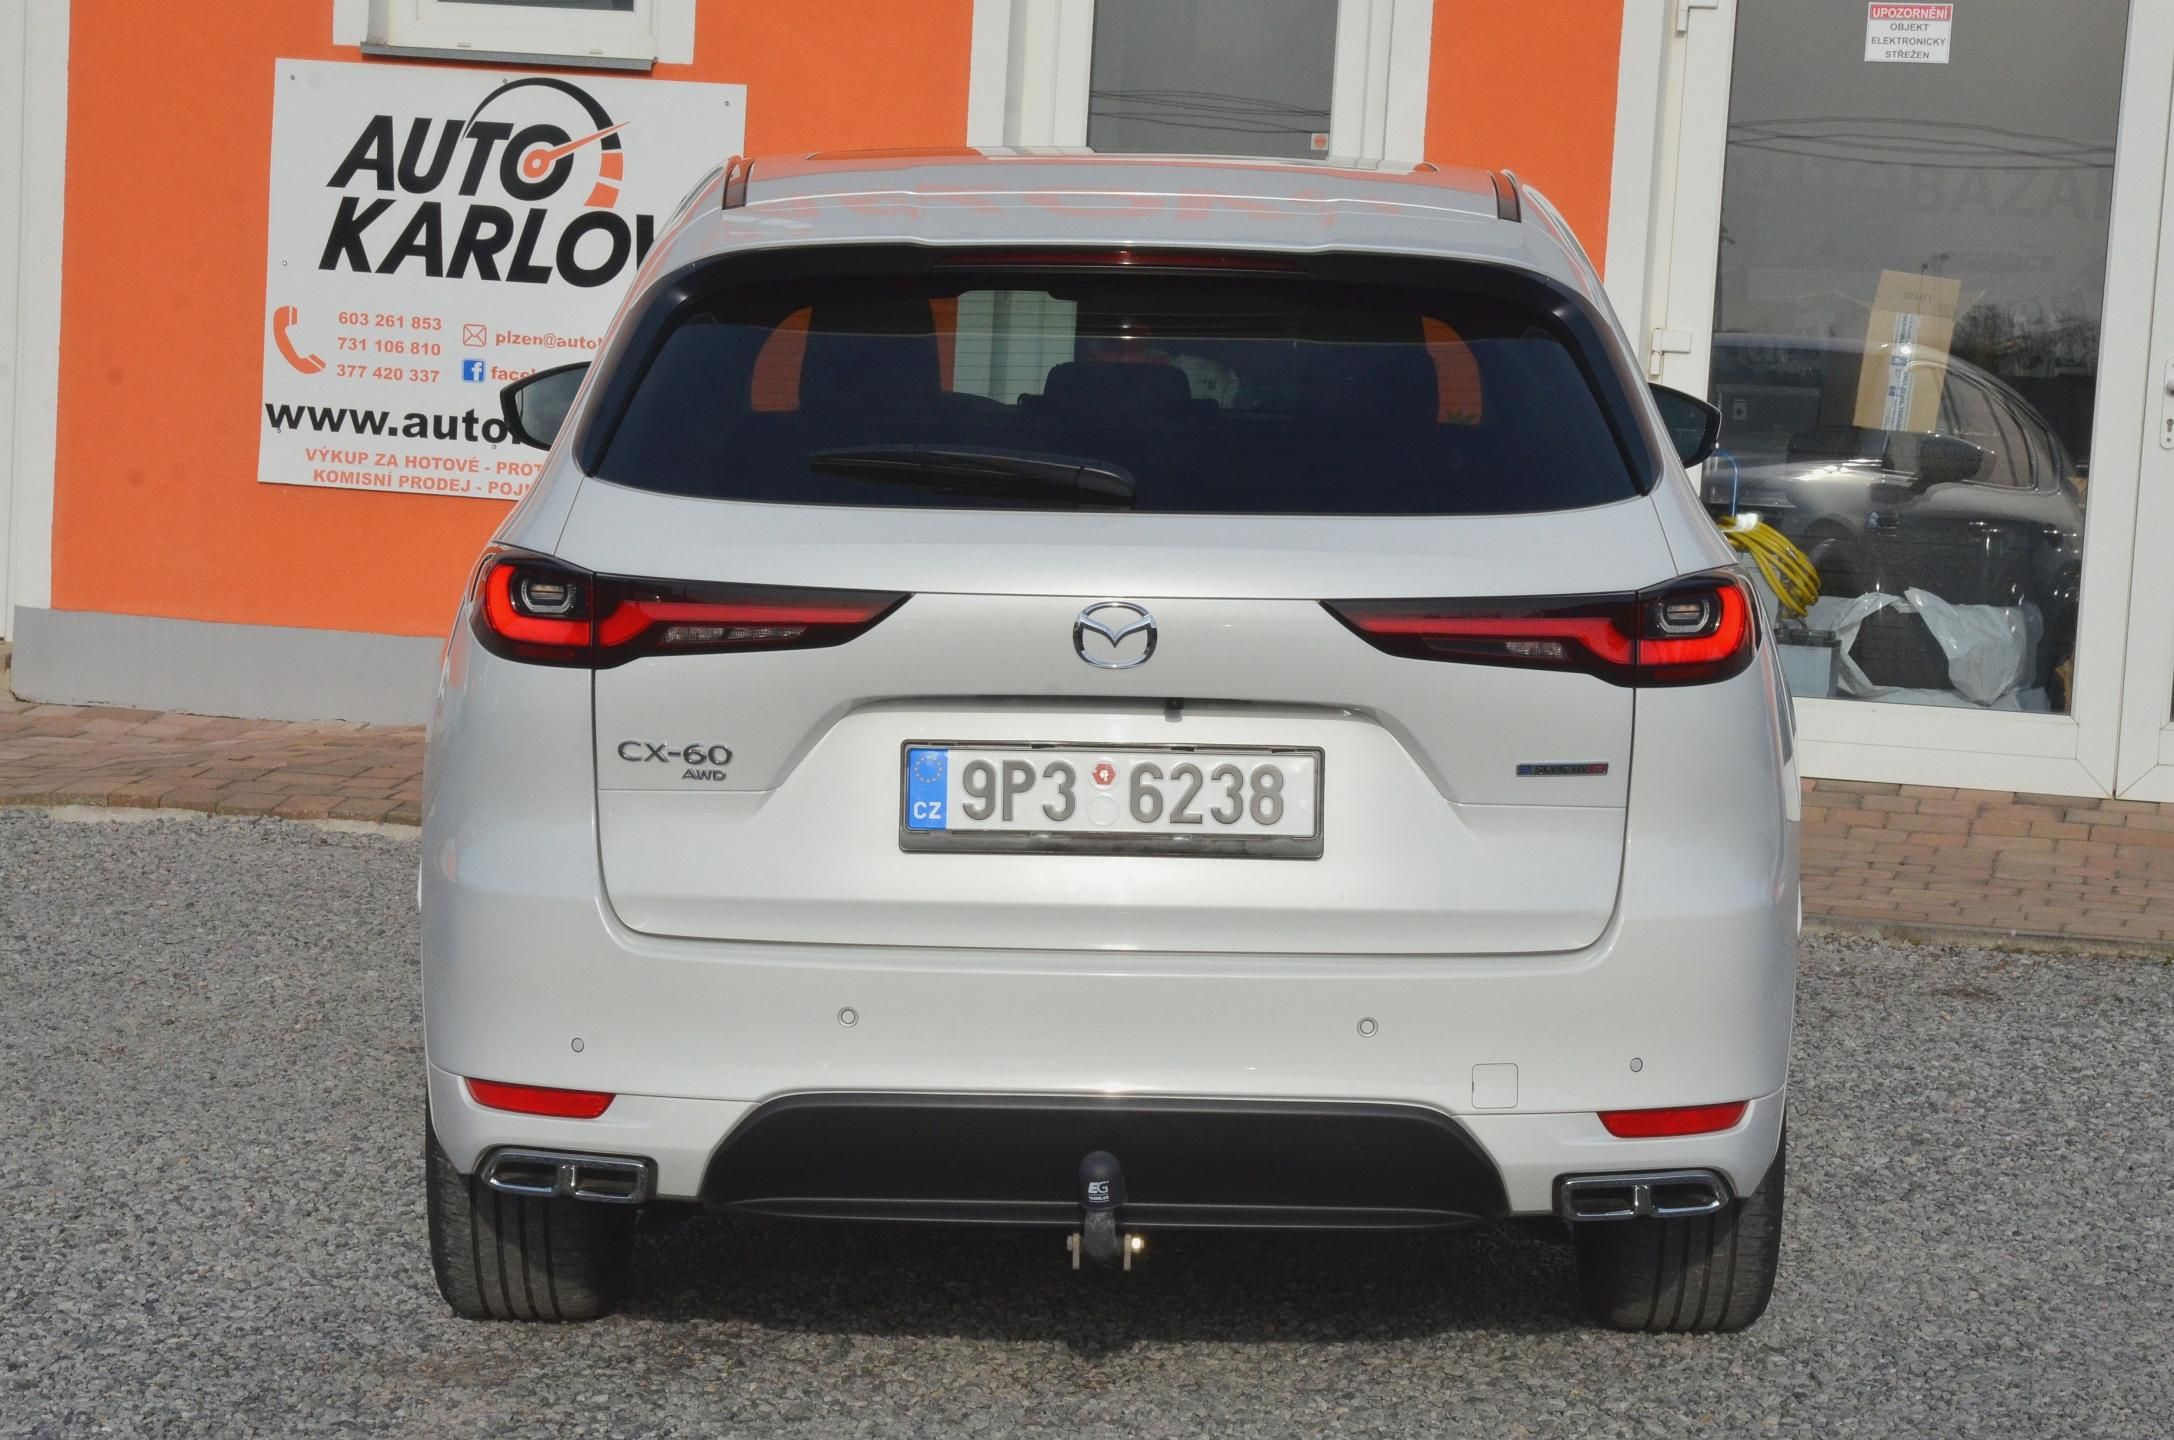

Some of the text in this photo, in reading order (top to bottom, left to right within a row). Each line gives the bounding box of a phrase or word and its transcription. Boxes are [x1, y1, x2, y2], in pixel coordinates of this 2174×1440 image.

[1872, 6, 1948, 19] UPOZORNĚNÍ
[1890, 23, 1929, 32] OBJEKT
[1871, 36, 1946, 46] ELEKTRONICKY
[326, 114, 575, 202] AUTO
[338, 312, 442, 330] 603 261 853
[337, 337, 441, 356] 731 106 810
[495, 331, 603, 350] plzen@auto
[336, 364, 440, 383] 377 420 337
[491, 366, 536, 382] fac
[265, 403, 521, 445] www.auto
[305, 446, 369, 464] VÝKUP
[374, 453, 399, 468] ZA
[405, 455, 479, 473] HOTOVÉ
[313, 469, 392, 487] KOMISNÍ
[399, 475, 471, 492] PRODEJ
[617, 741, 734, 766] CX-60
[682, 768, 727, 782] AWD
[913, 758, 1285, 826] CZ 9P3 6238
